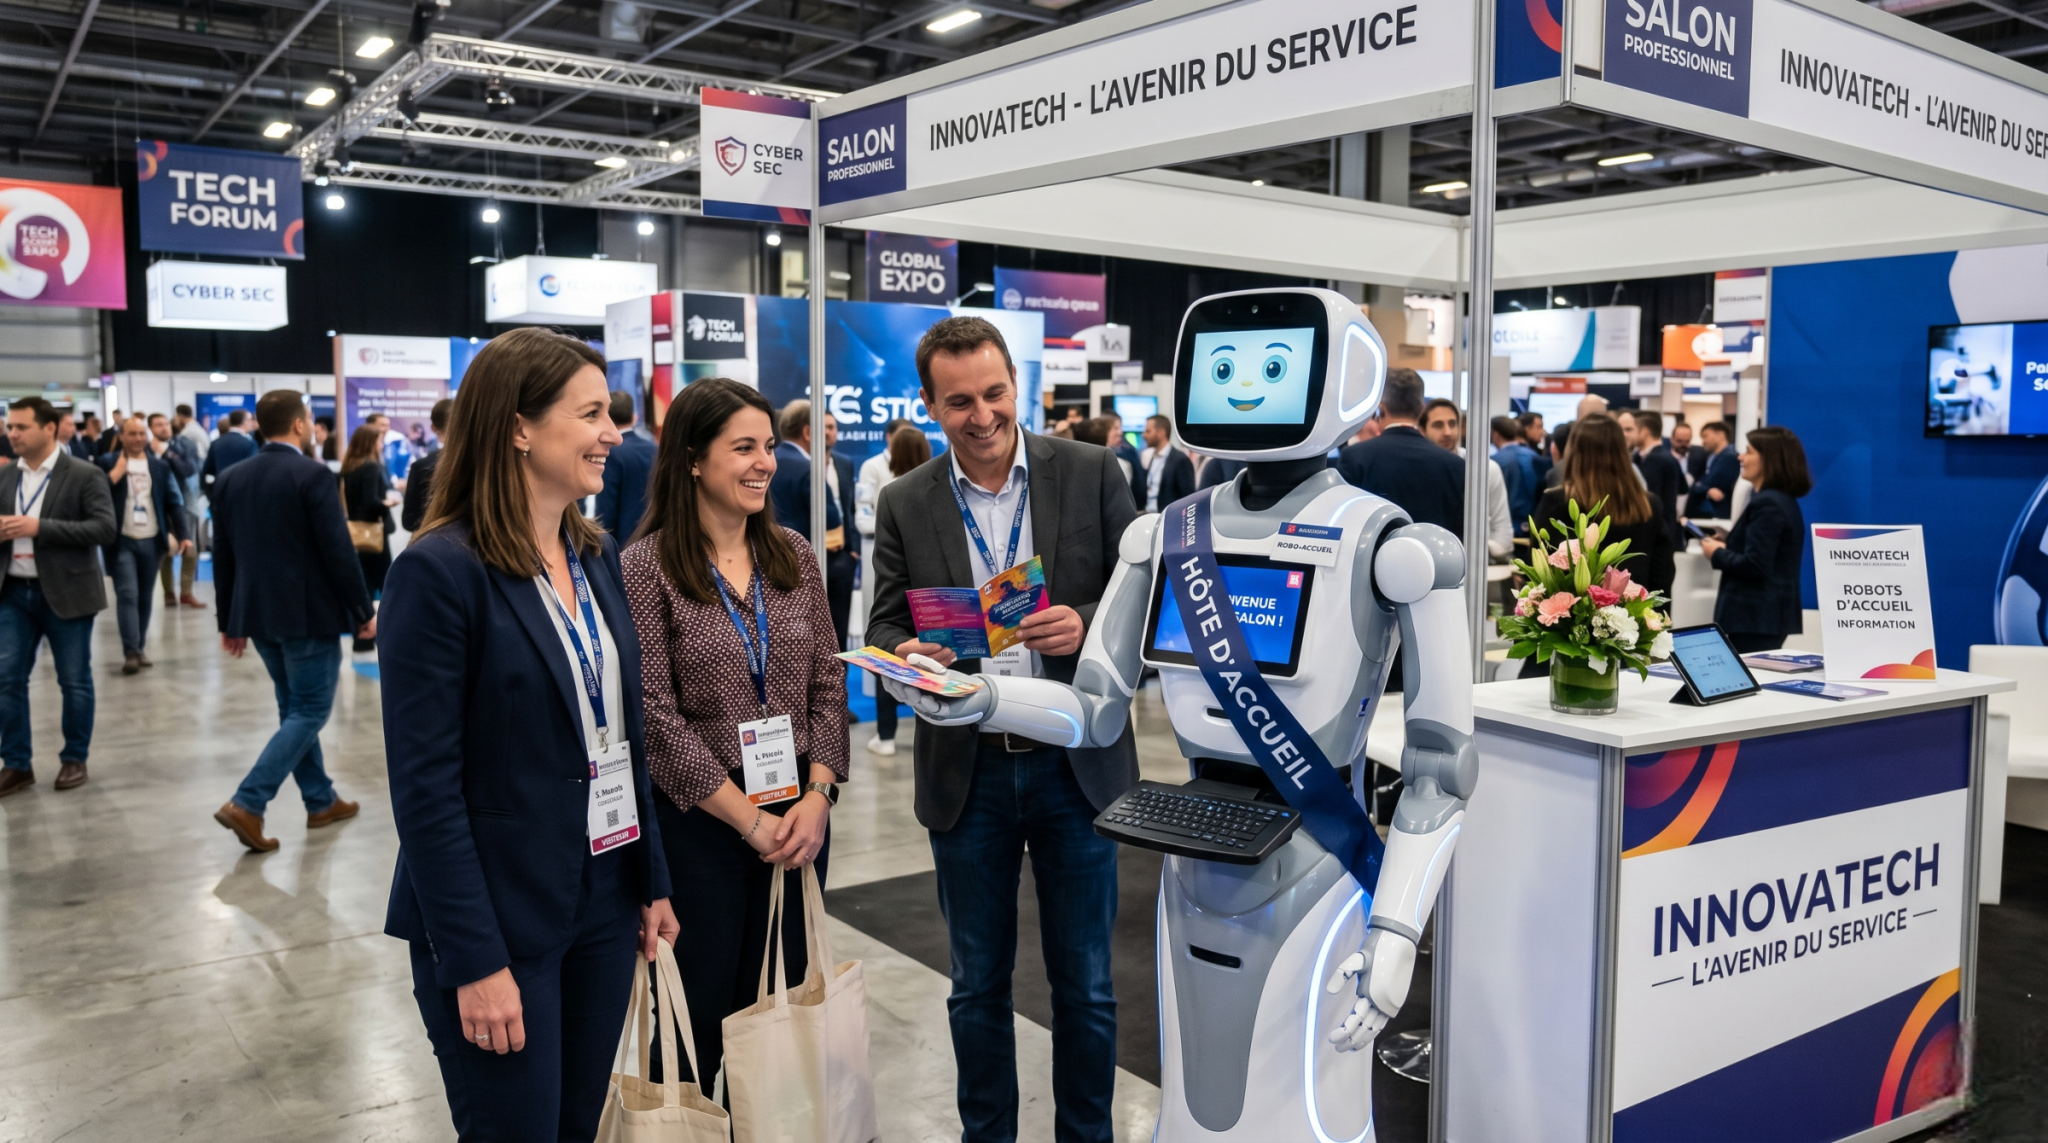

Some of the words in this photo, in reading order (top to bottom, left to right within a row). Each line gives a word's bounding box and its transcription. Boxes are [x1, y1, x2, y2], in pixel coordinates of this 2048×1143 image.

[1625, 0, 1736, 56] SALON
[1624, 33, 1735, 81] PROFESSIONNEL
[930, 91, 1066, 151] INNOVATECH
[1073, 101, 1082, 109] -
[1090, 58, 1206, 115] L'AVENIR
[1215, 44, 1257, 87] DU
[1266, 4, 1418, 74] SERVICE
[1780, 48, 1910, 119] INNOVATECH
[1926, 95, 1997, 145] L'AVENIR
[2000, 118, 2022, 151] DU
[753, 143, 803, 162] CYBER
[827, 124, 895, 166] SALON
[753, 161, 783, 176] SEC
[827, 157, 895, 183] PROFESSIONNEL
[168, 169, 277, 207] TECH
[170, 202, 278, 232] FORUM
[19, 224, 59, 239] TECH
[879, 250, 945, 271] GLOBAL
[172, 284, 235, 300] CYBER
[241, 287, 275, 301] SEC
[879, 269, 946, 294] EXPO
[707, 318, 736, 331] TECH
[707, 331, 745, 343] FORUM
[870, 396, 936, 424] STIC
[1277, 541, 1333, 553] ROBO-ACCUEIL
[1829, 549, 1910, 561] INNOVATECH
[1843, 584, 1903, 596] ROBOTS
[1836, 600, 1913, 612] D'ACCUEIL
[1837, 619, 1916, 630] INFORMATION
[1180, 556, 1223, 637] HÔTE
[1208, 638, 1313, 791] D'ACCUEIL
[1653, 842, 1940, 957] INNOVATECH
[1691, 940, 1788, 986] L'AVENIR
[1793, 929, 1823, 960] DU
[1828, 908, 1908, 950] SERVICE
